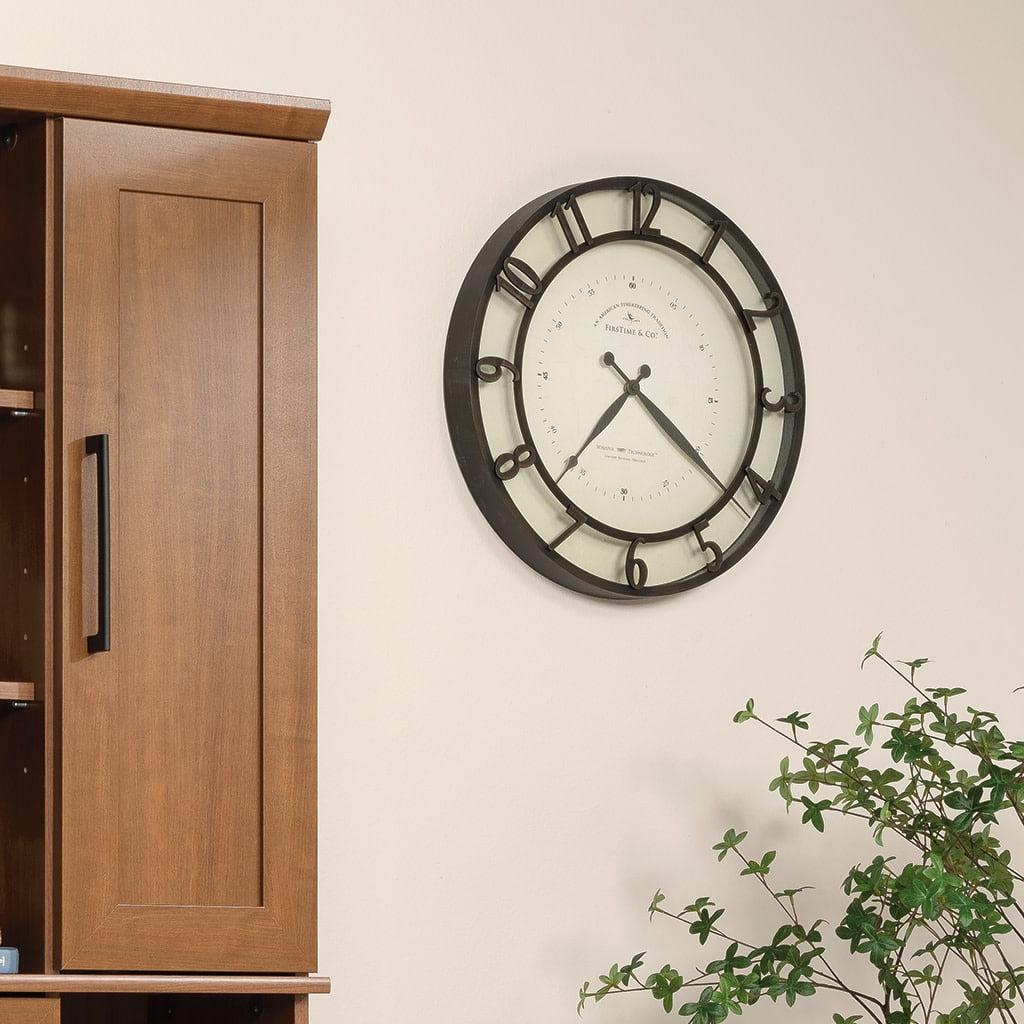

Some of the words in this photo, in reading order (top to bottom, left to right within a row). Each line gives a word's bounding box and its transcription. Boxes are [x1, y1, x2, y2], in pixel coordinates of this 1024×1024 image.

[550, 193, 593, 254] 11
[627, 182, 662, 237] 12
[706, 219, 728, 264] 1
[495, 256, 543, 311] 10
[476, 356, 521, 383] 9
[761, 386, 802, 414] 3
[494, 443, 537, 481] 8
[745, 466, 783, 507] 4
[544, 503, 589, 551] 7
[692, 519, 724, 573] 5
[626, 537, 649, 591] 6
